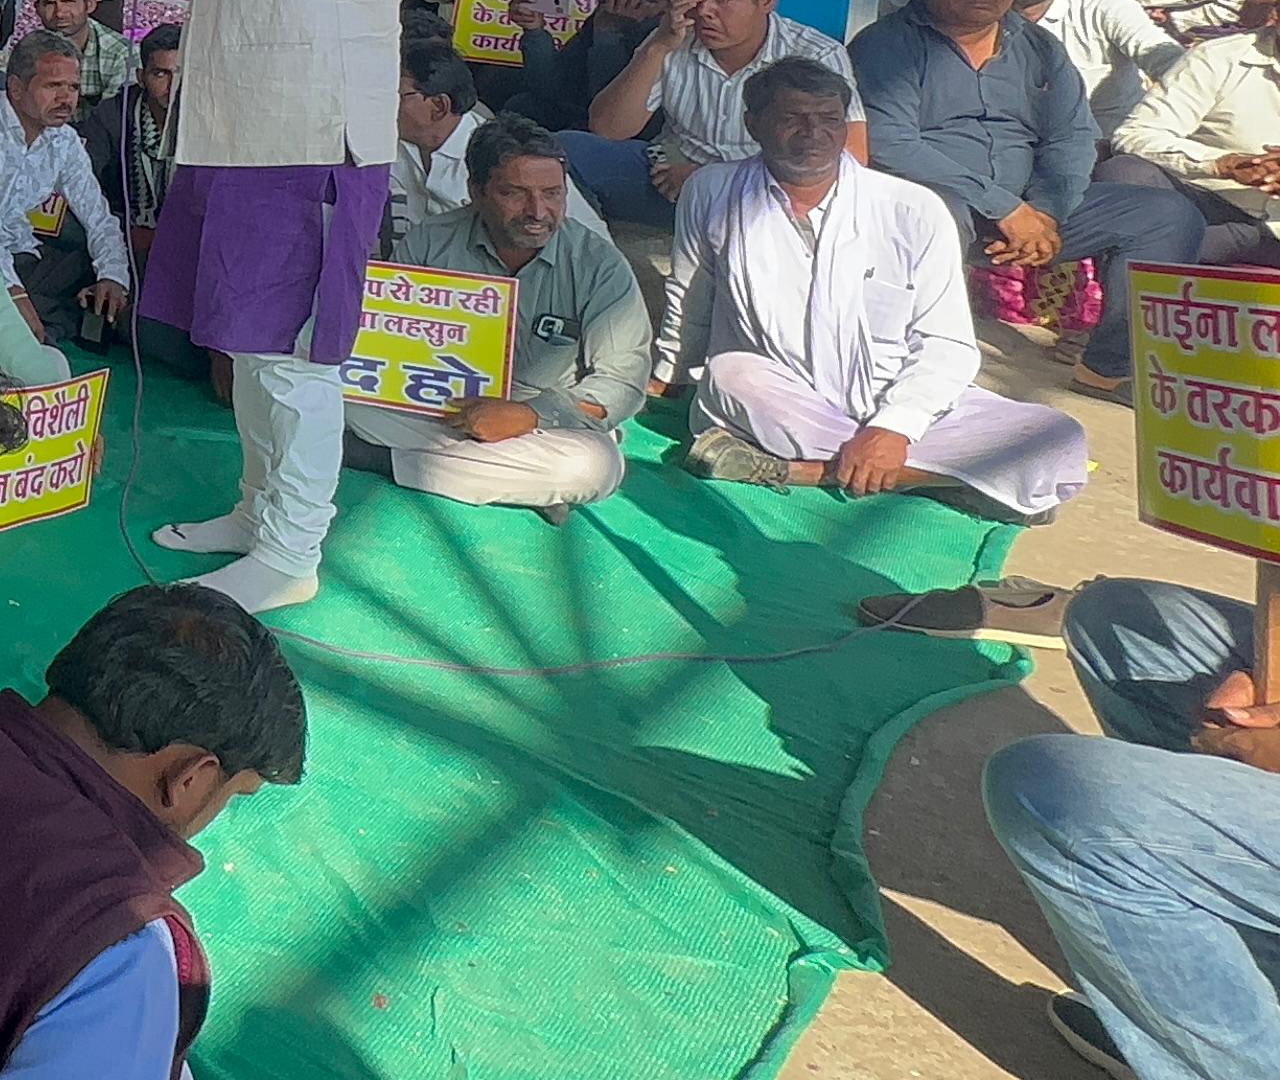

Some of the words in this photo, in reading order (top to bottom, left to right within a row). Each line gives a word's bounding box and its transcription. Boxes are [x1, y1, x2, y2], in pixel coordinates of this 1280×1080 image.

[474, 2, 494, 22] के
[390, 276, 413, 301] से
[419, 287, 453, 307] आ
[457, 287, 501, 314] रही
[1140, 281, 1239, 351] चाईना
[384, 314, 467, 346] लहसुन
[402, 355, 490, 405] हो
[1149, 354, 1178, 414] के
[25, 383, 89, 438] विशैली
[14, 455, 44, 498] बंद
[49, 441, 86, 490] करो
